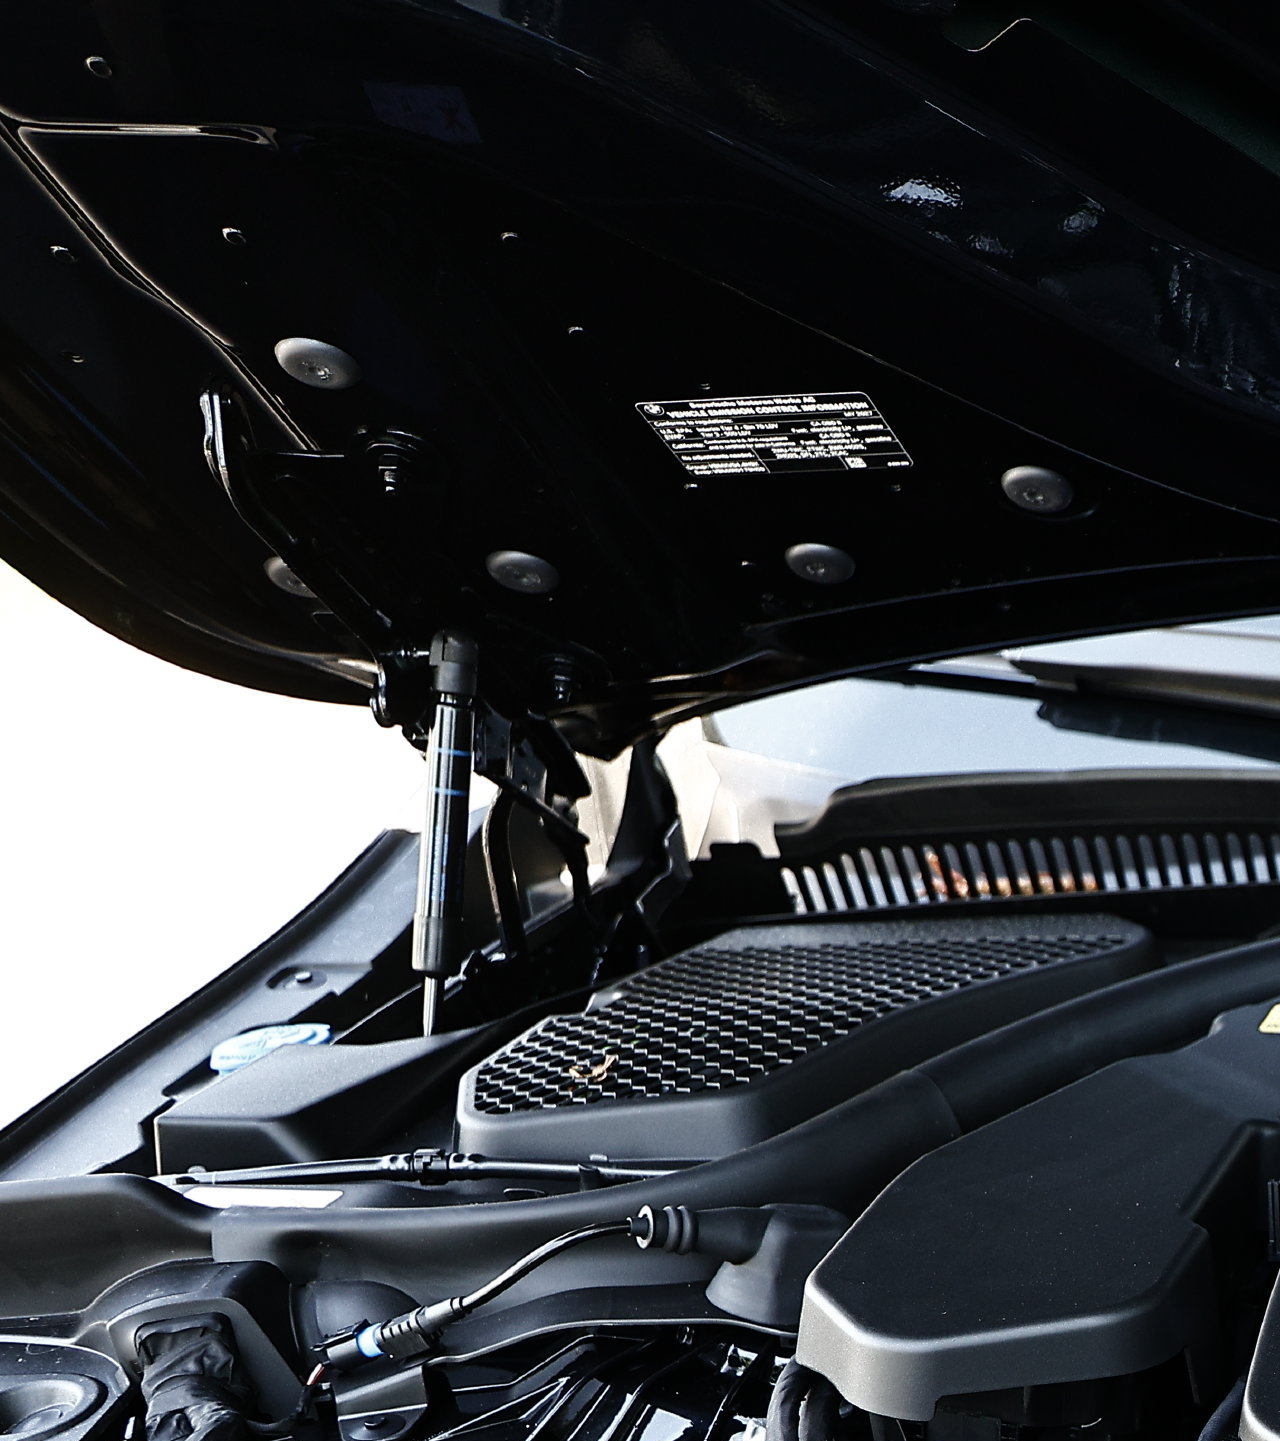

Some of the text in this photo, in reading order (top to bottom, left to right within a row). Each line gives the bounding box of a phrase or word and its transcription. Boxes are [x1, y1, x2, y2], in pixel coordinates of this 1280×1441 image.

[666, 402, 869, 418] VEHICLE EMISSION CONTROL INFORMATION
[689, 401, 736, 409] Bayerische
